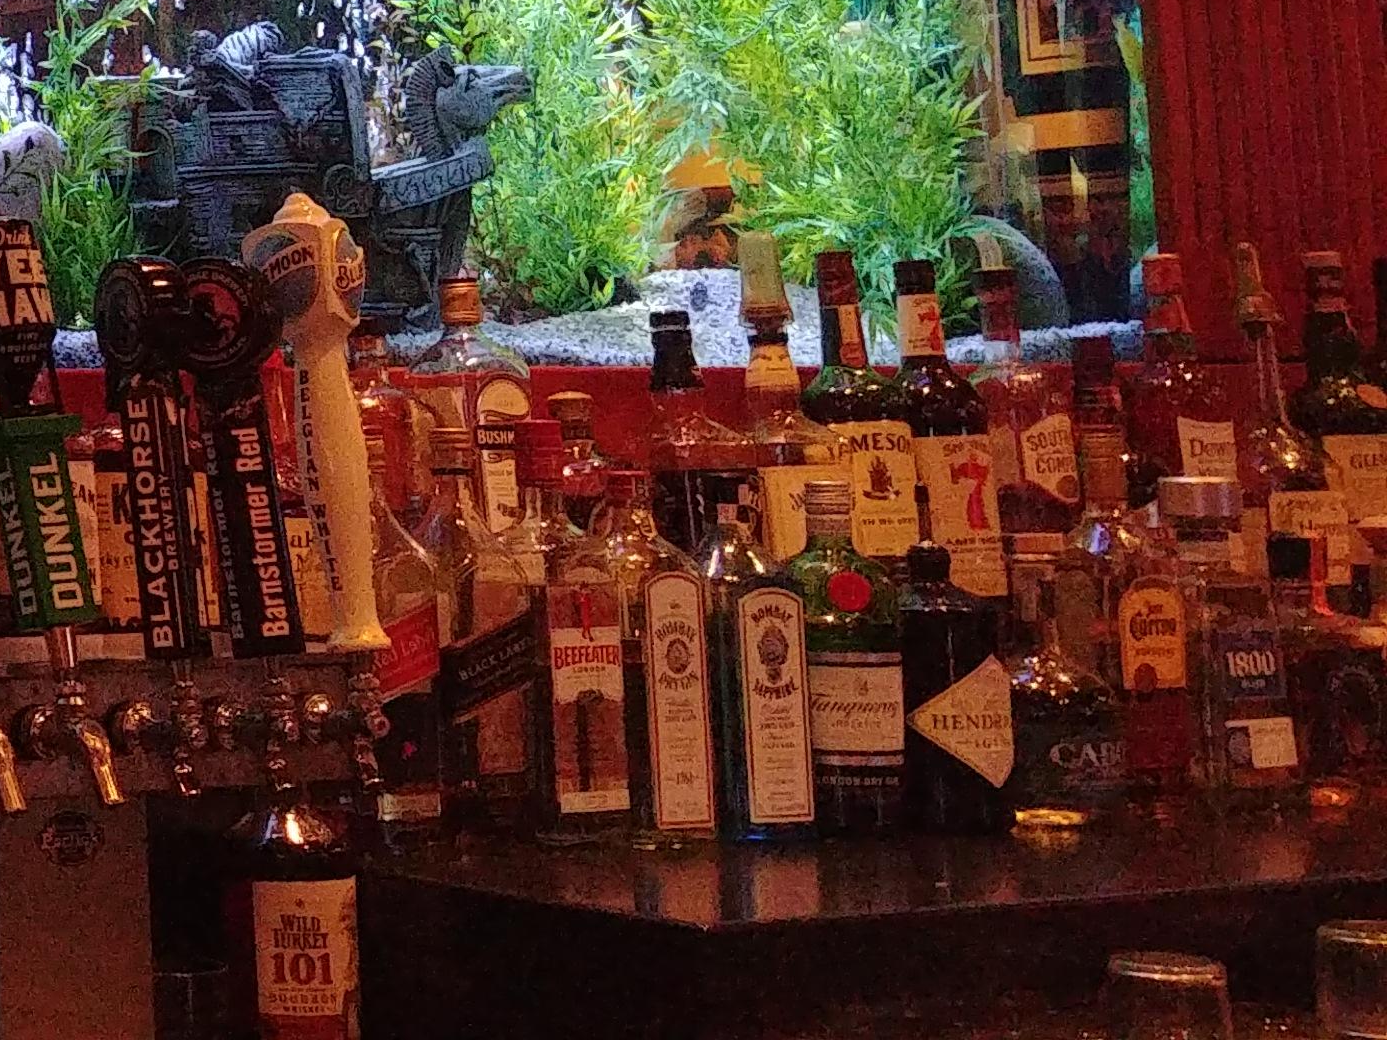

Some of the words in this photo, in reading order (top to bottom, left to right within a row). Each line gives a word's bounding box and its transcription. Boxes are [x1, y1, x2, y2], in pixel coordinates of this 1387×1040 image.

[269, 245, 314, 279] MOON
[231, 427, 263, 472] Red
[299, 370, 319, 491] BELGIAN
[29, 452, 84, 609] DUNKEL
[127, 398, 173, 648] BLACKHORSE
[158, 474, 178, 570] BREWERY
[246, 482, 290, 637] Barnstormer
[554, 645, 621, 668] BEEFEATER
[1226, 651, 1275, 677] 1800
[274, 927, 330, 951] TURKEY
[279, 913, 322, 932] WILD
[270, 952, 334, 985] 101
